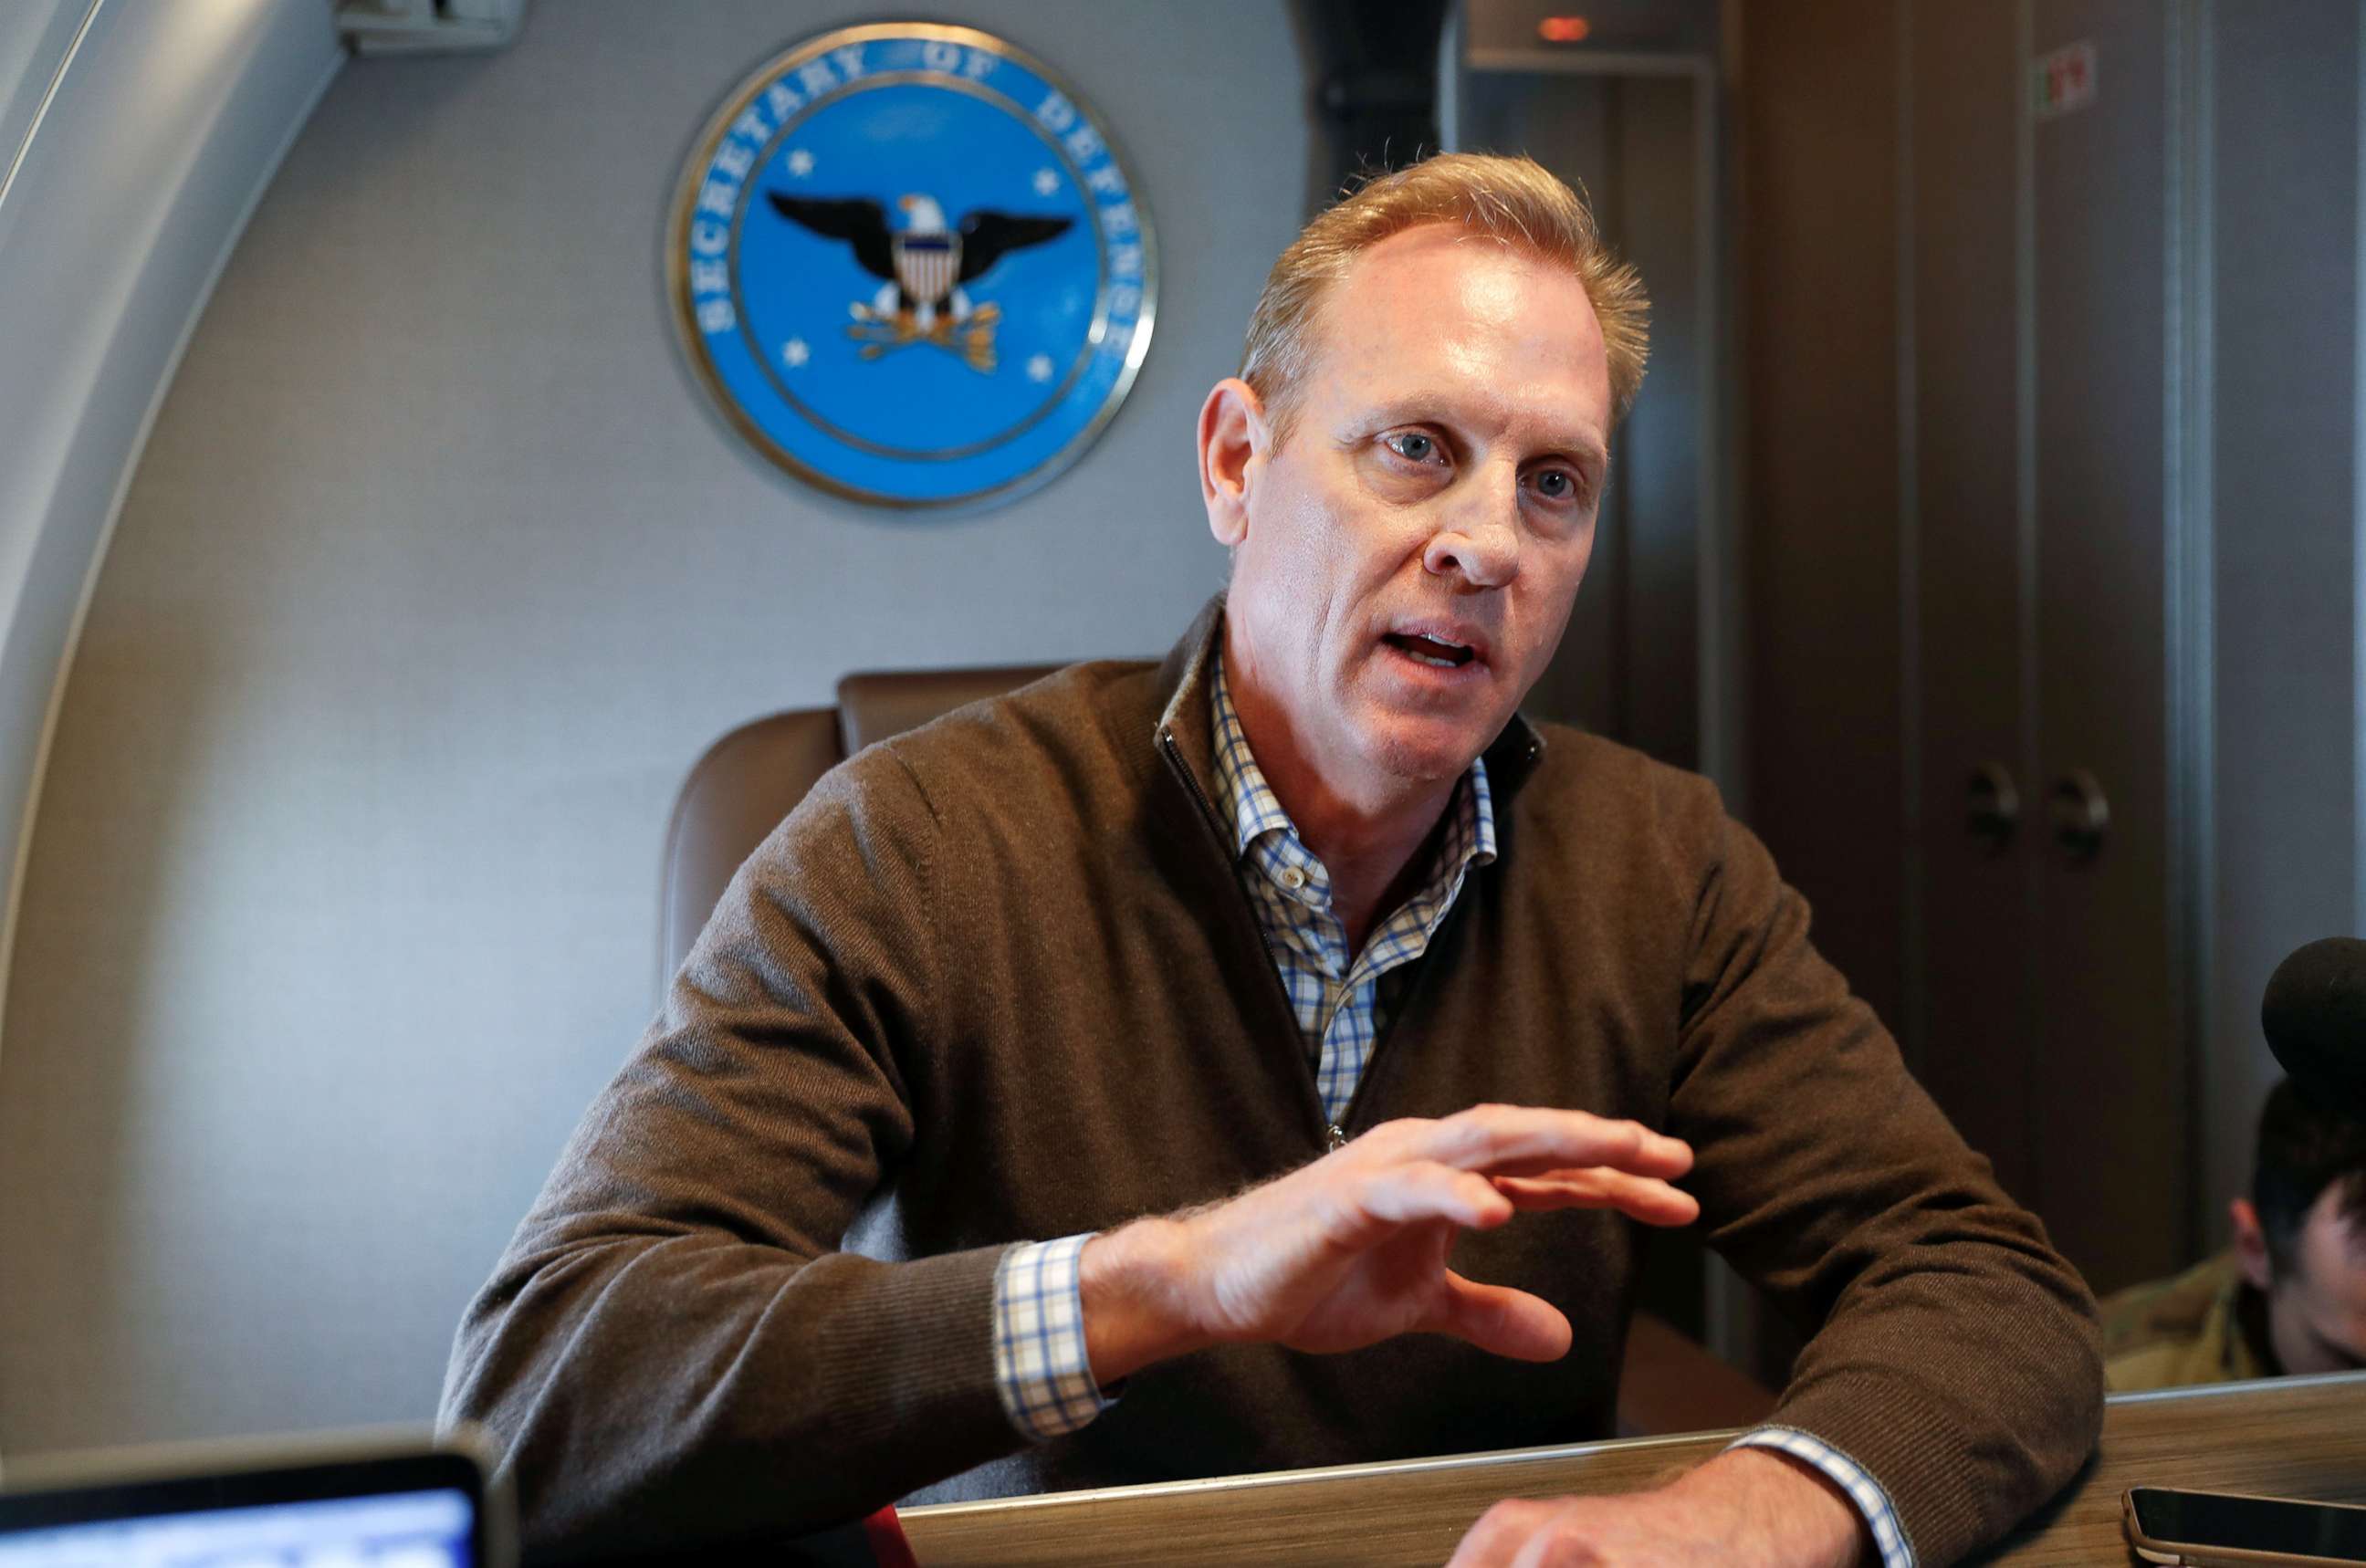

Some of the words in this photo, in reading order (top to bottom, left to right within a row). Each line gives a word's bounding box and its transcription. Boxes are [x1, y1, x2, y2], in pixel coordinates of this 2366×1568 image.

[690, 42, 868, 333] SECRETARY
[922, 41, 997, 82] OF
[1036, 89, 1143, 357] DEFENSE
